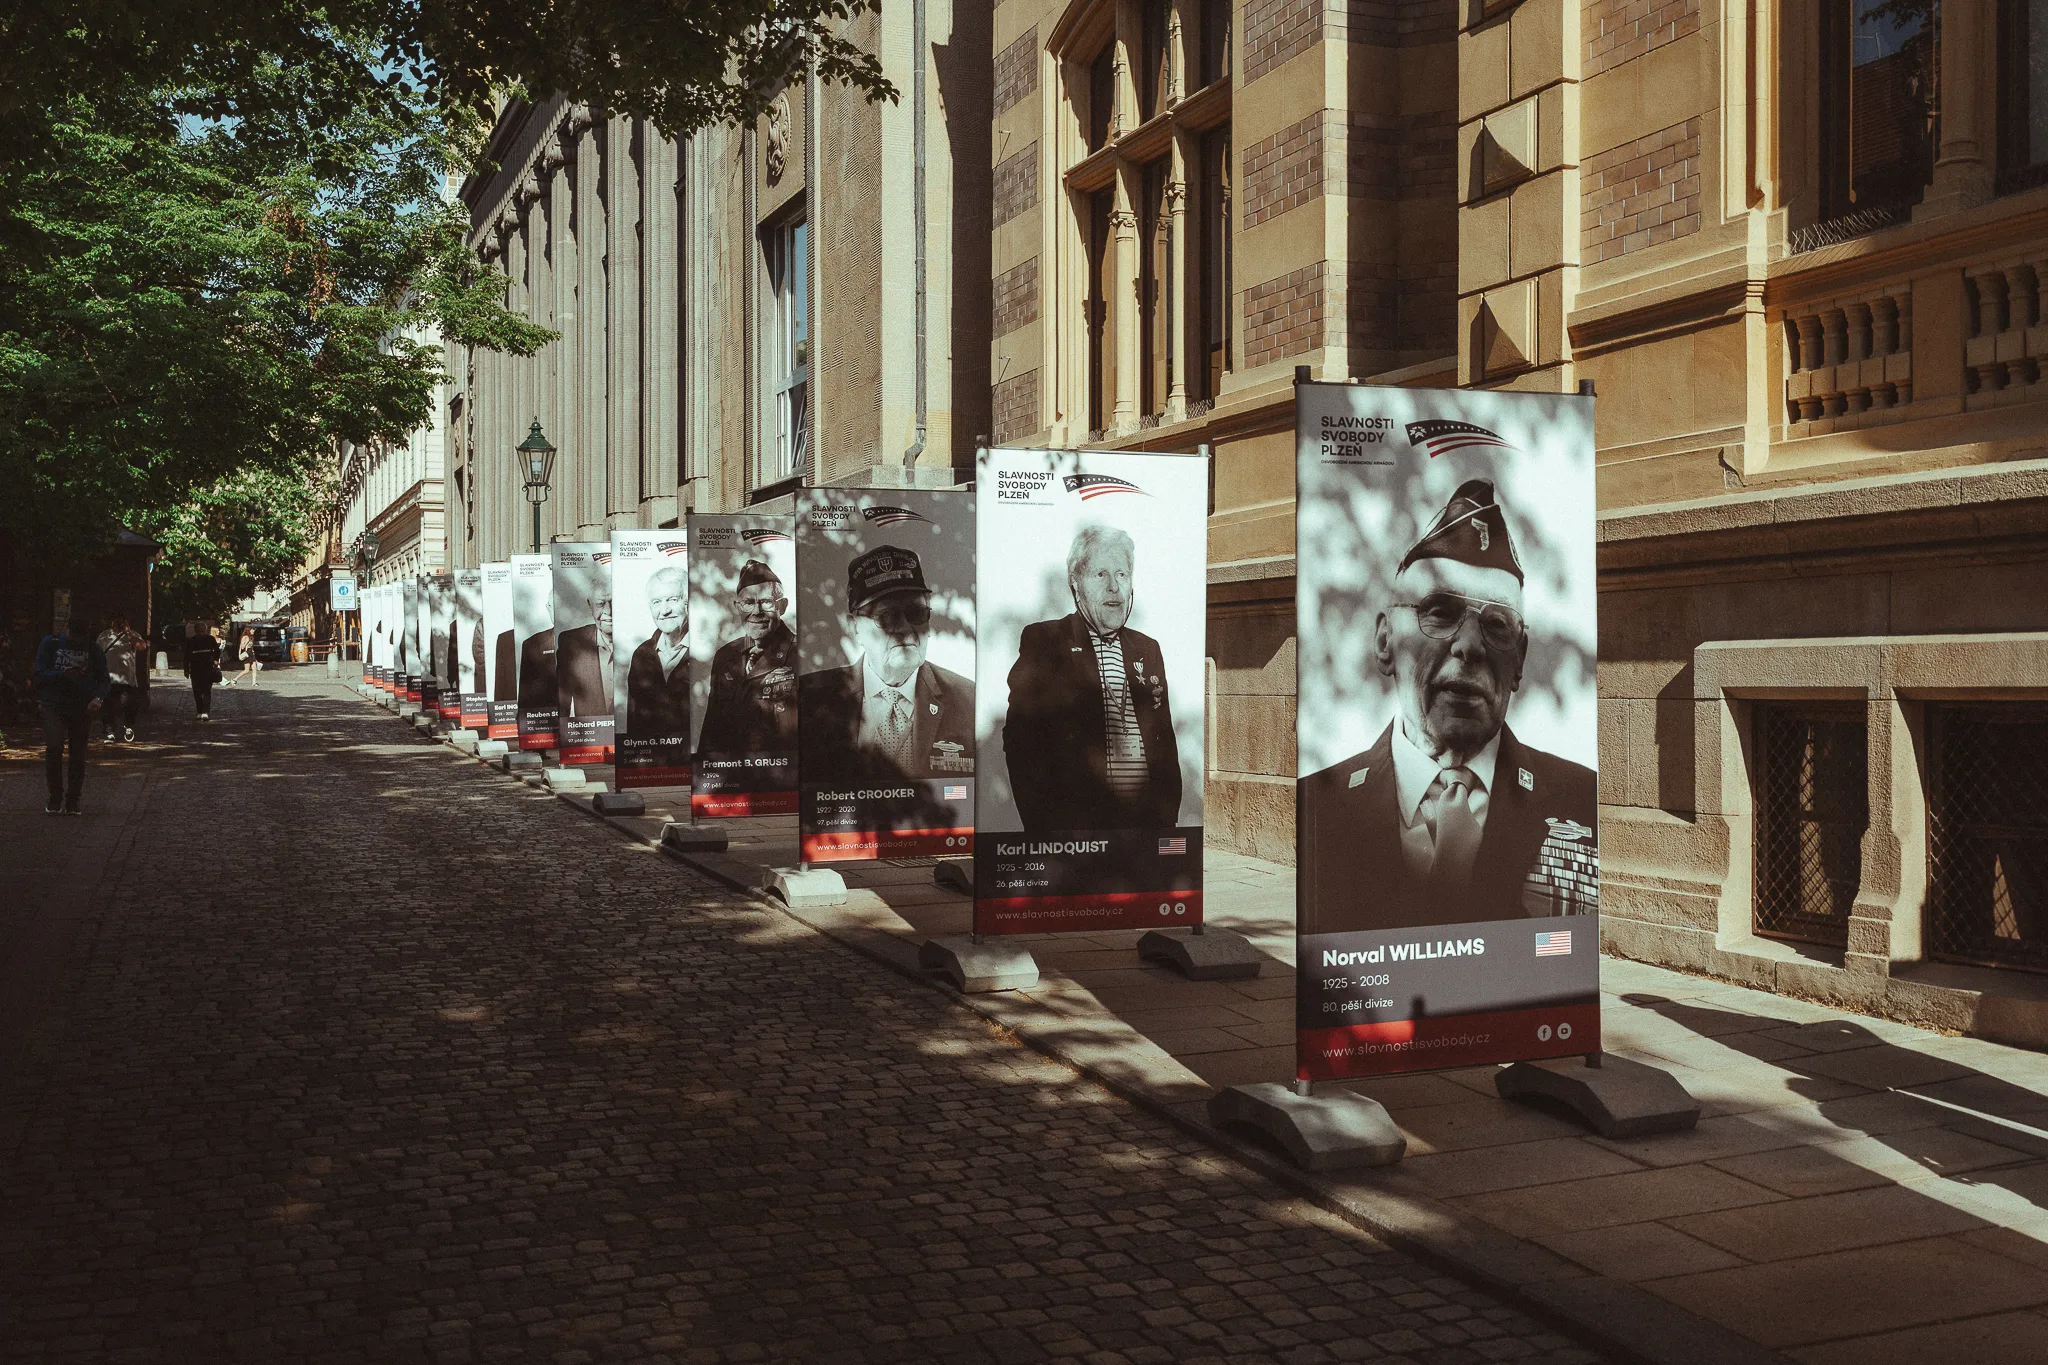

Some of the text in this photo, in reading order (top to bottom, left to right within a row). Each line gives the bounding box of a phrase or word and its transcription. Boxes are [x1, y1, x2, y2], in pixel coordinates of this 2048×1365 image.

[1321, 416, 1394, 430] SLAVNOSTI
[1321, 430, 1384, 443] SVOBODY
[1321, 442, 1362, 457] PLZEŇ
[998, 470, 1054, 481] SLAVNOSTI
[998, 481, 1047, 490] SVOBODY
[998, 489, 1030, 499] PLZEŇ
[811, 505, 856, 513] SLAVNOSTI
[812, 519, 837, 527] PLZEŇ
[624, 739, 647, 747] Glynn
[703, 758, 788, 768] Fremont B. GRUSS
[817, 788, 915, 801] Robert CROOKER
[817, 806, 832, 814] 1922
[997, 840, 1108, 856] Karl LINDQUIST
[996, 863, 1016, 872] 1925
[1025, 863, 1045, 871] 2016
[1008, 879, 1025, 889] pěší
[1027, 879, 1049, 887] divize
[996, 907, 1123, 919] www.slavnostisvobody.cz
[1323, 938, 1485, 967] Norval WILLIAMS
[1322, 978, 1348, 990] 1925
[1360, 974, 1390, 987] 2008
[1322, 998, 1394, 1013] 80. pěší divize
[1322, 1033, 1490, 1058] www.slavnostisvobody.cz
